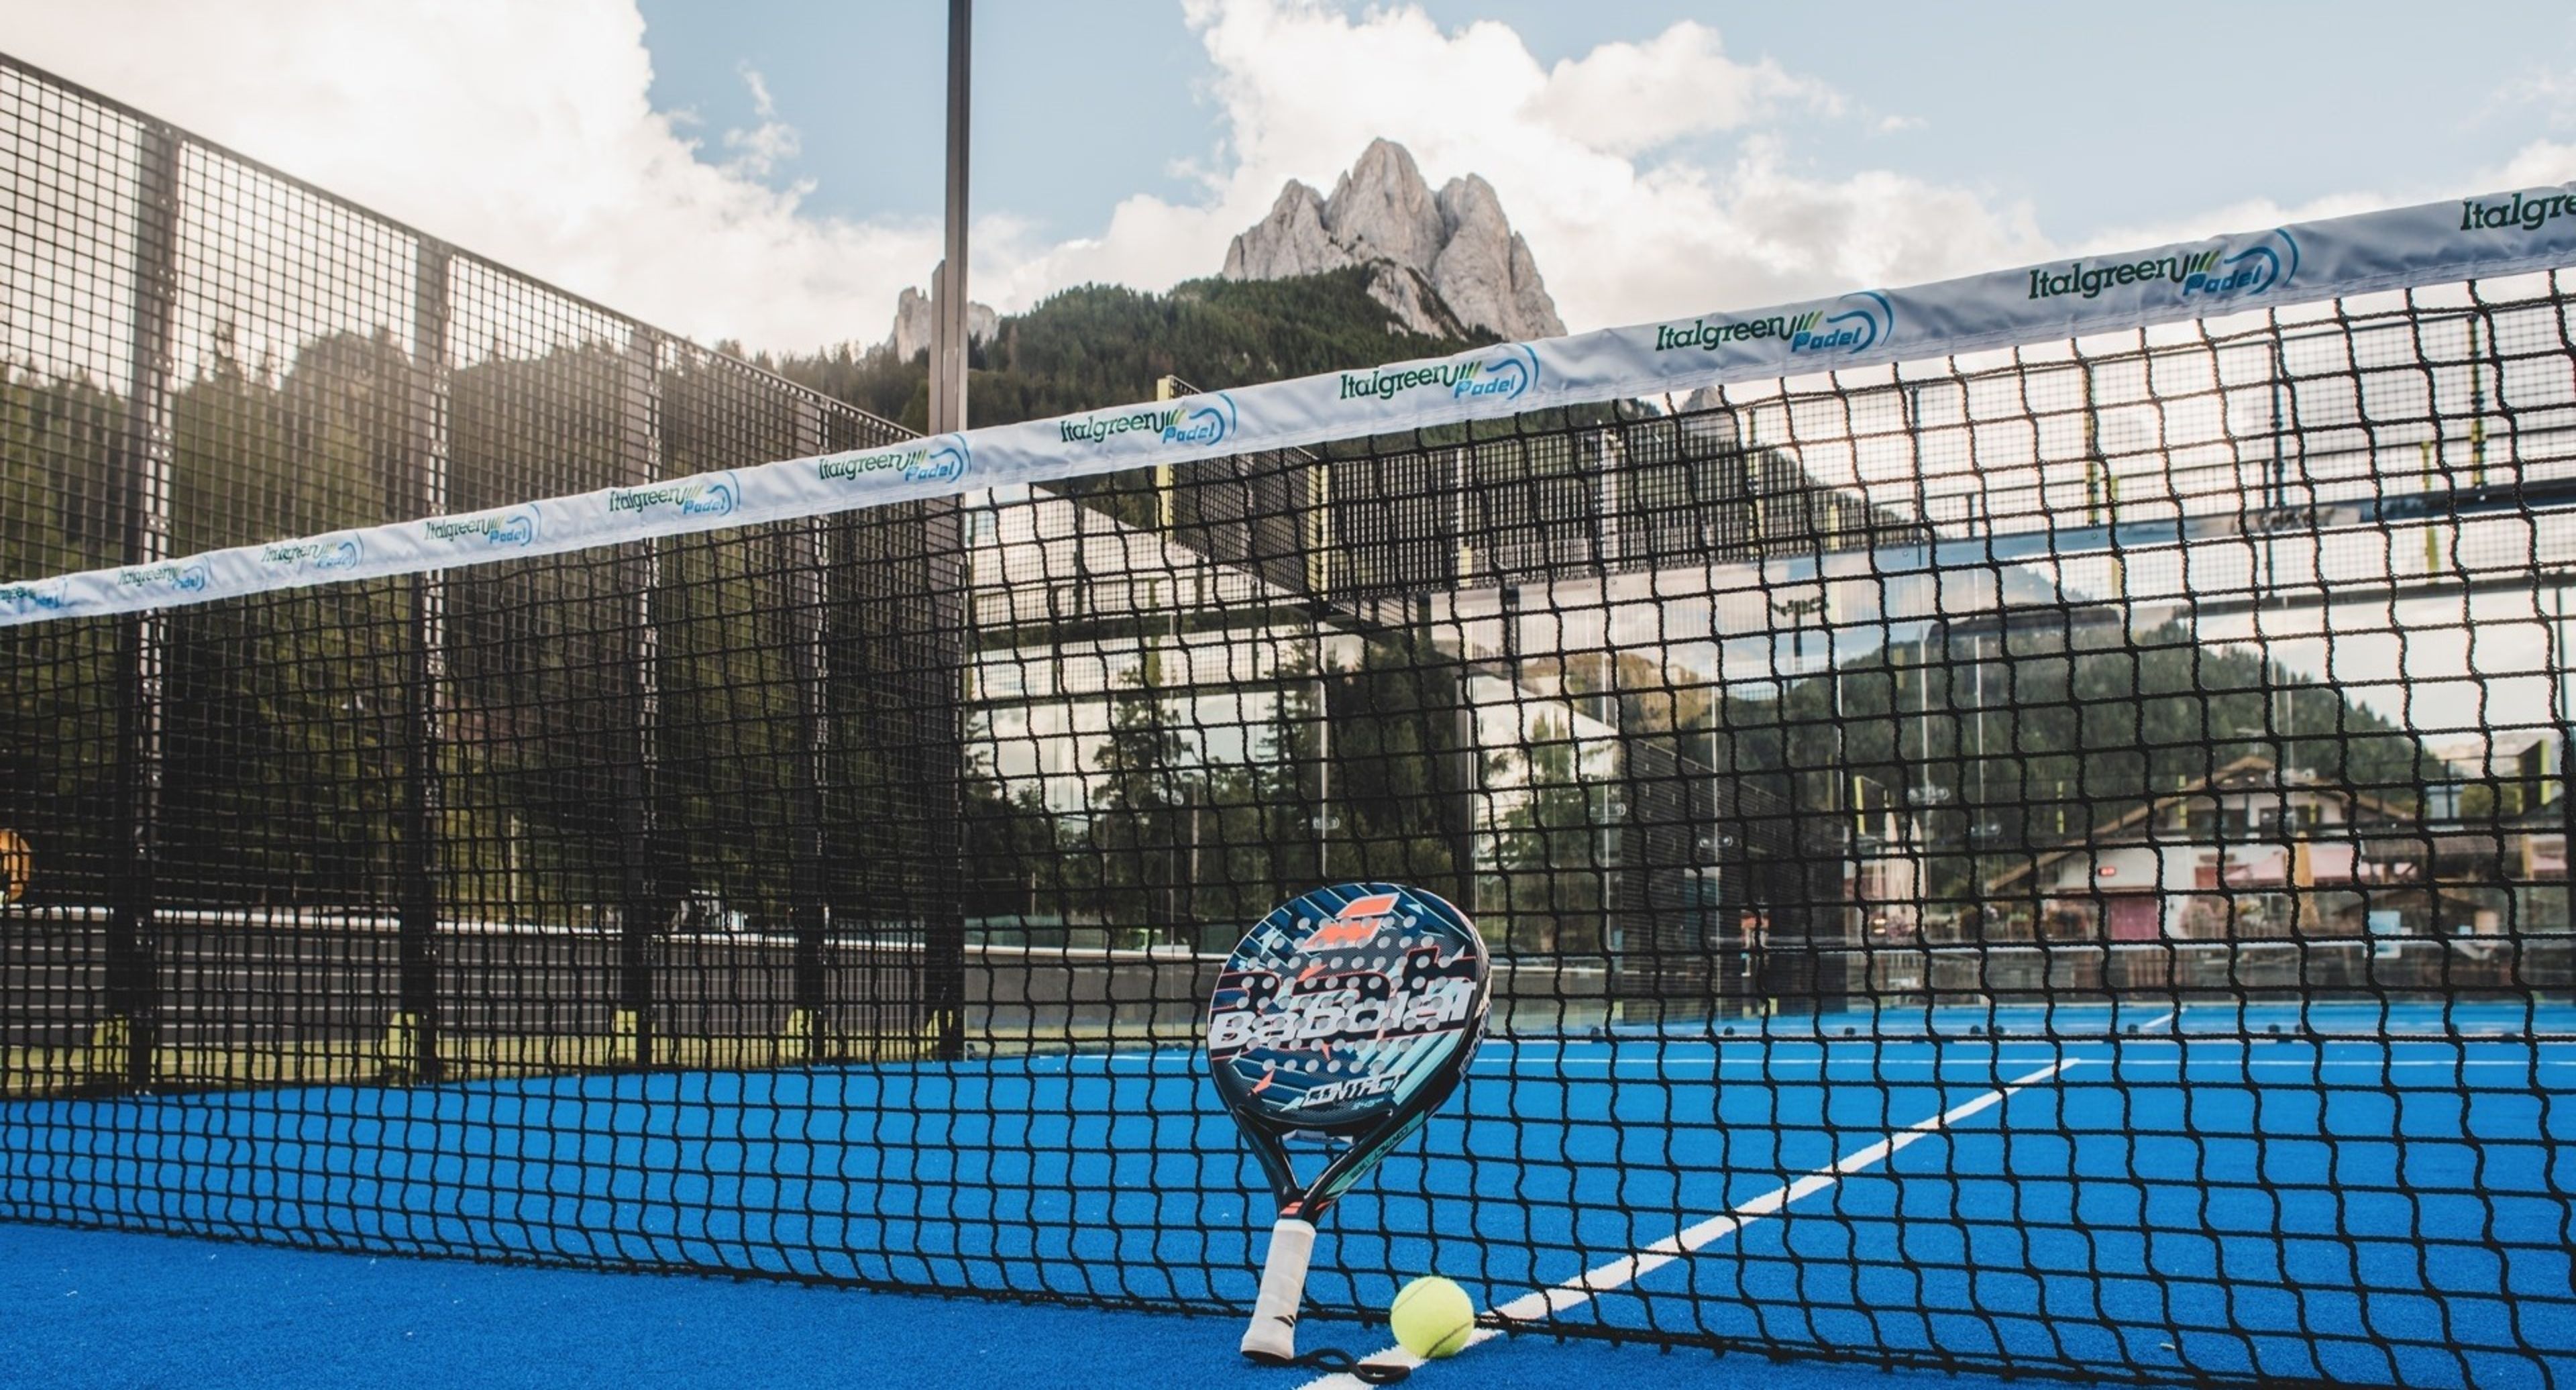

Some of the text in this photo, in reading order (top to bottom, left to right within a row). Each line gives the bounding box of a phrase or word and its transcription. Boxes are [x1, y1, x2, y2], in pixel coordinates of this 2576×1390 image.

[2029, 254, 2190, 299] Italgreen
[2182, 265, 2262, 297] Padel
[1656, 315, 1796, 352] Italgreen
[1791, 327, 1862, 352] Padel
[1340, 364, 1459, 400] Italgreen
[1453, 374, 1517, 398] Padel
[1061, 411, 1165, 443] Italgreen
[1163, 422, 1216, 443] Padel
[819, 453, 910, 480] Italgreen
[905, 461, 955, 482] Padel
[609, 488, 686, 513] Italgreen
[683, 497, 725, 515] Padel
[425, 519, 492, 542] Italgreen
[489, 527, 527, 544] Padel
[1209, 977, 1477, 1050] Babolat
[1301, 1069, 1408, 1108] CONTACT
